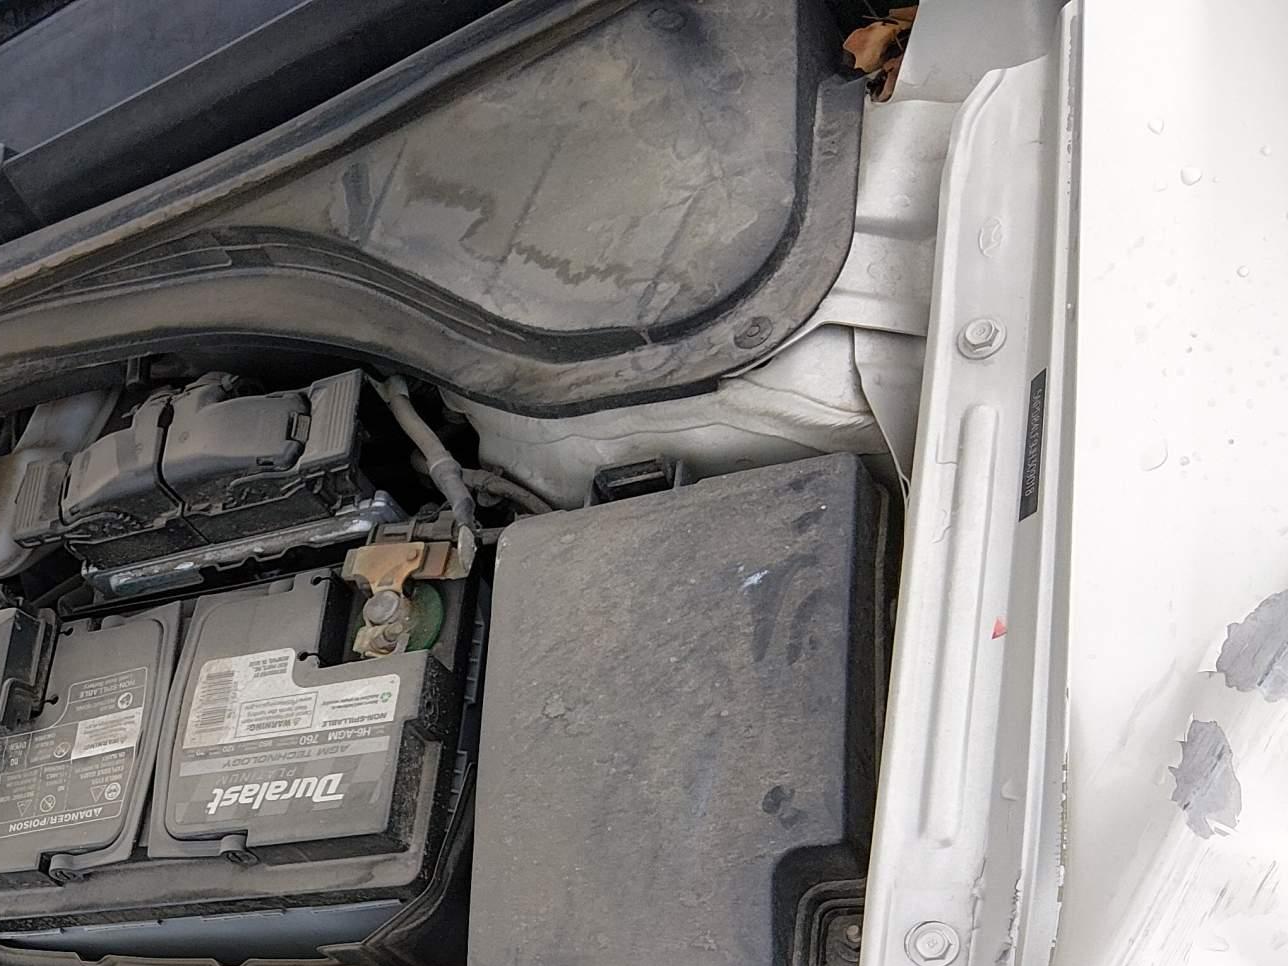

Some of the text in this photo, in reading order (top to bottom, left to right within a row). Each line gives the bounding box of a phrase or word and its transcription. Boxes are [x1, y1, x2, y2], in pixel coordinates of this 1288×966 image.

[245, 719, 292, 732] WARNING:
[320, 712, 388, 728] NON-SPILLABLE
[298, 734, 319, 745] 760
[328, 726, 371, 741] H6-AGM
[222, 750, 313, 768] TECHNOLOGY
[316, 744, 351, 758] AGM
[215, 766, 297, 784] PLATINUM
[207, 772, 345, 815] Duralast
[8, 808, 93, 833] DANGER/POISON
